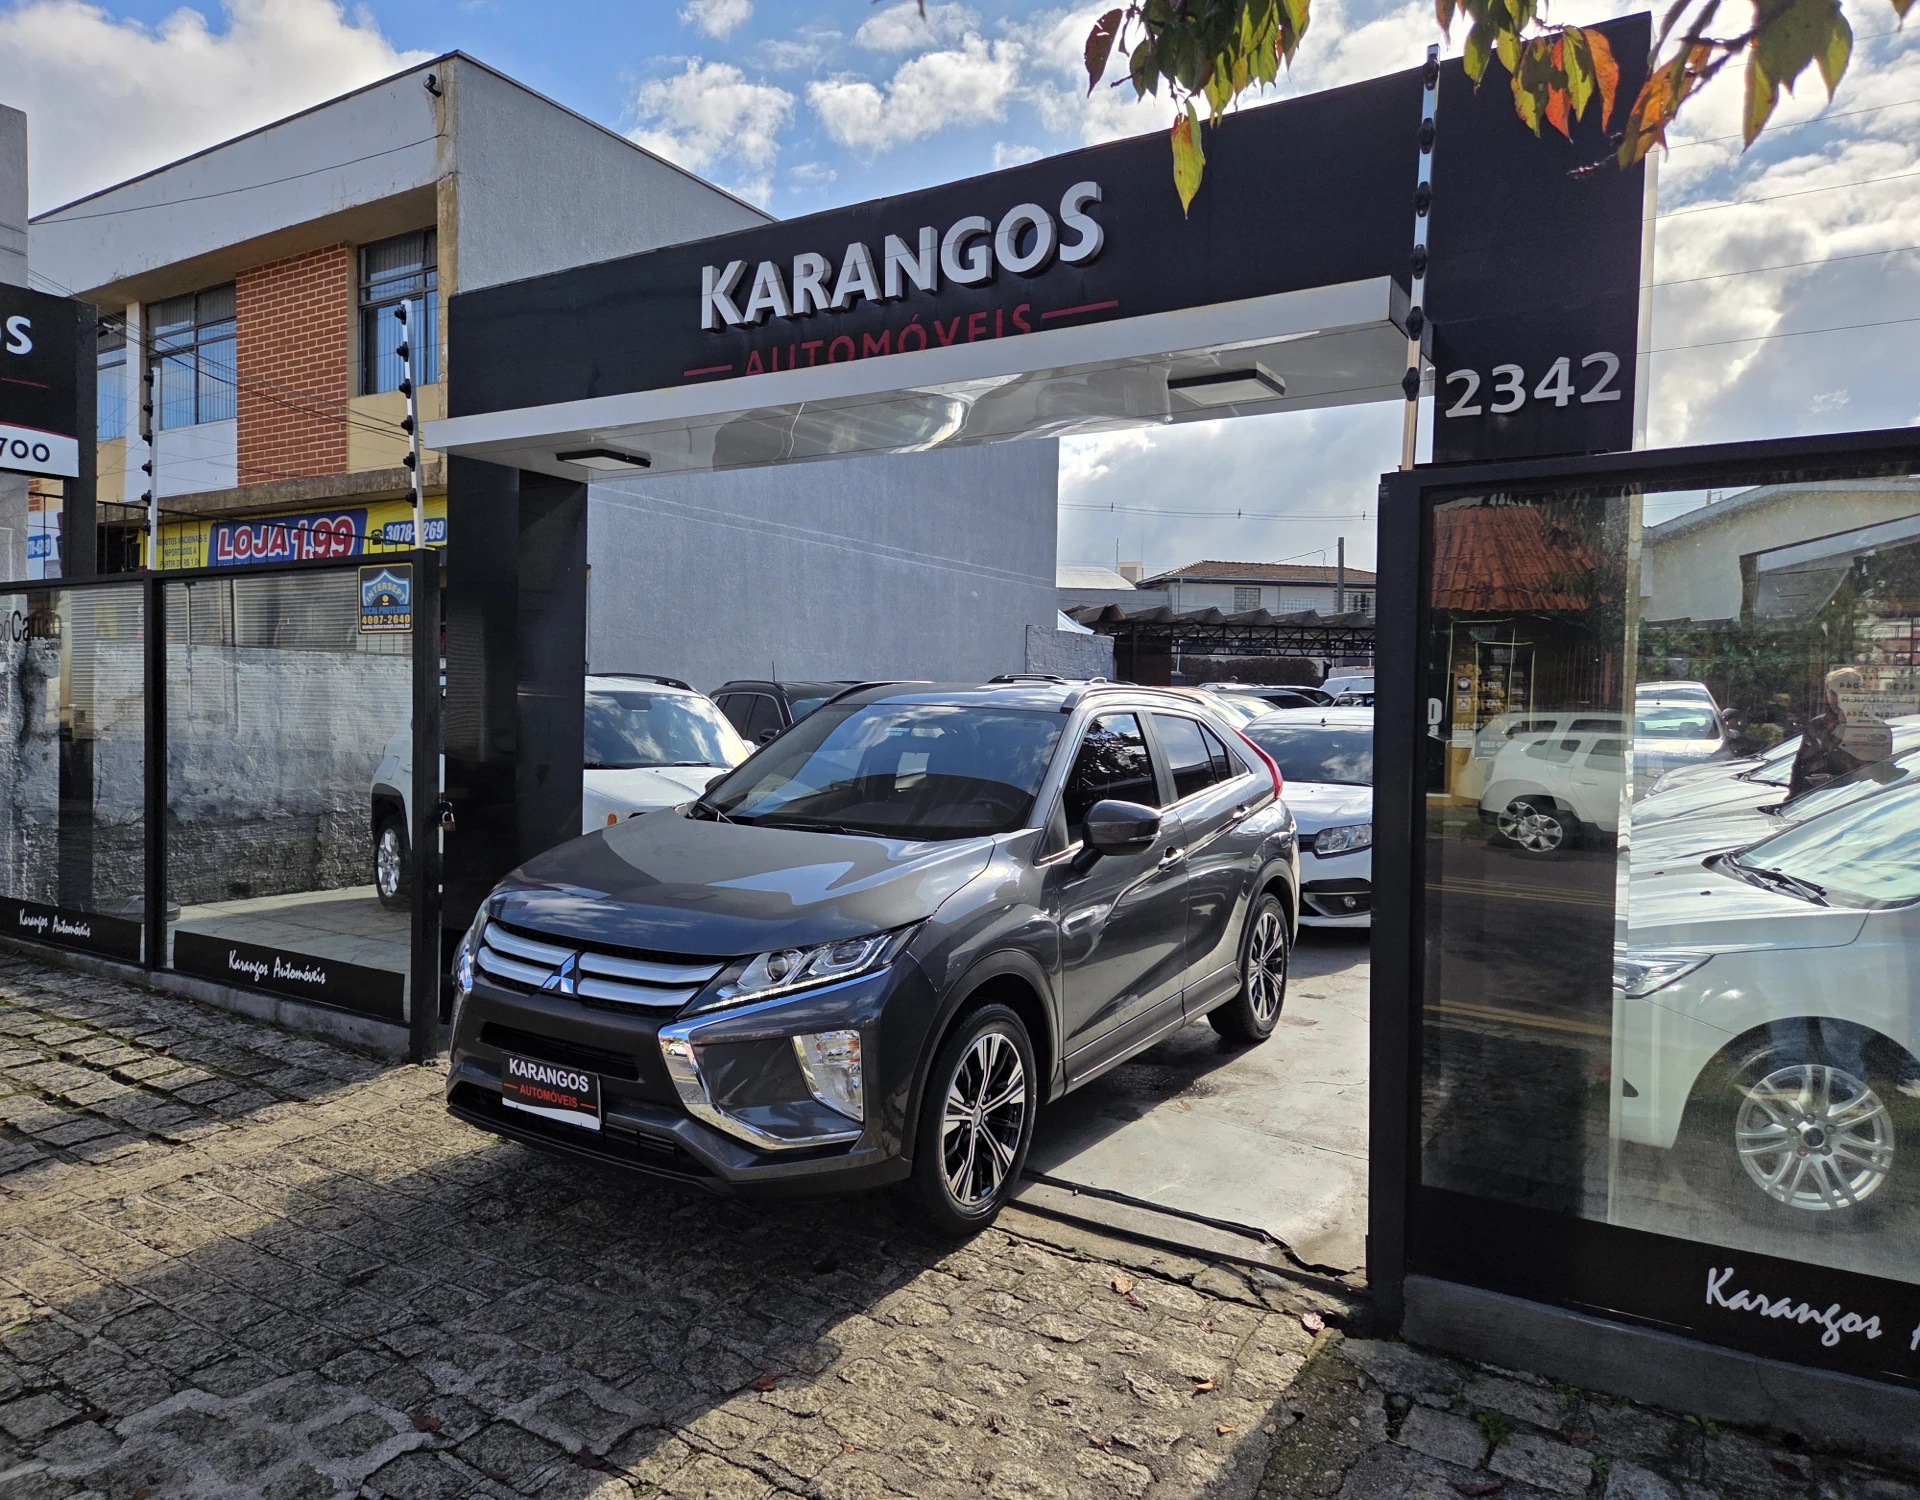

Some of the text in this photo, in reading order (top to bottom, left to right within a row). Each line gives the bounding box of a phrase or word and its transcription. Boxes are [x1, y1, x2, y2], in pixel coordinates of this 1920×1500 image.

[701, 181, 1104, 332] KARANGOS
[745, 303, 1031, 377] AUTOMÓVEIS
[1445, 352, 1622, 418] 2342
[218, 522, 290, 560] LOJA
[385, 520, 445, 542] 3078-269
[366, 581, 406, 602] INTERSEPT
[362, 614, 410, 624] 4007-2640
[20, 908, 91, 937] Karangos Automóveis
[228, 949, 326, 984] Karangos Automóveis
[509, 1057, 589, 1093] KARANGOS
[520, 1084, 578, 1108] AUTOMÓVEIS
[1705, 1267, 1883, 1347] Karangos
